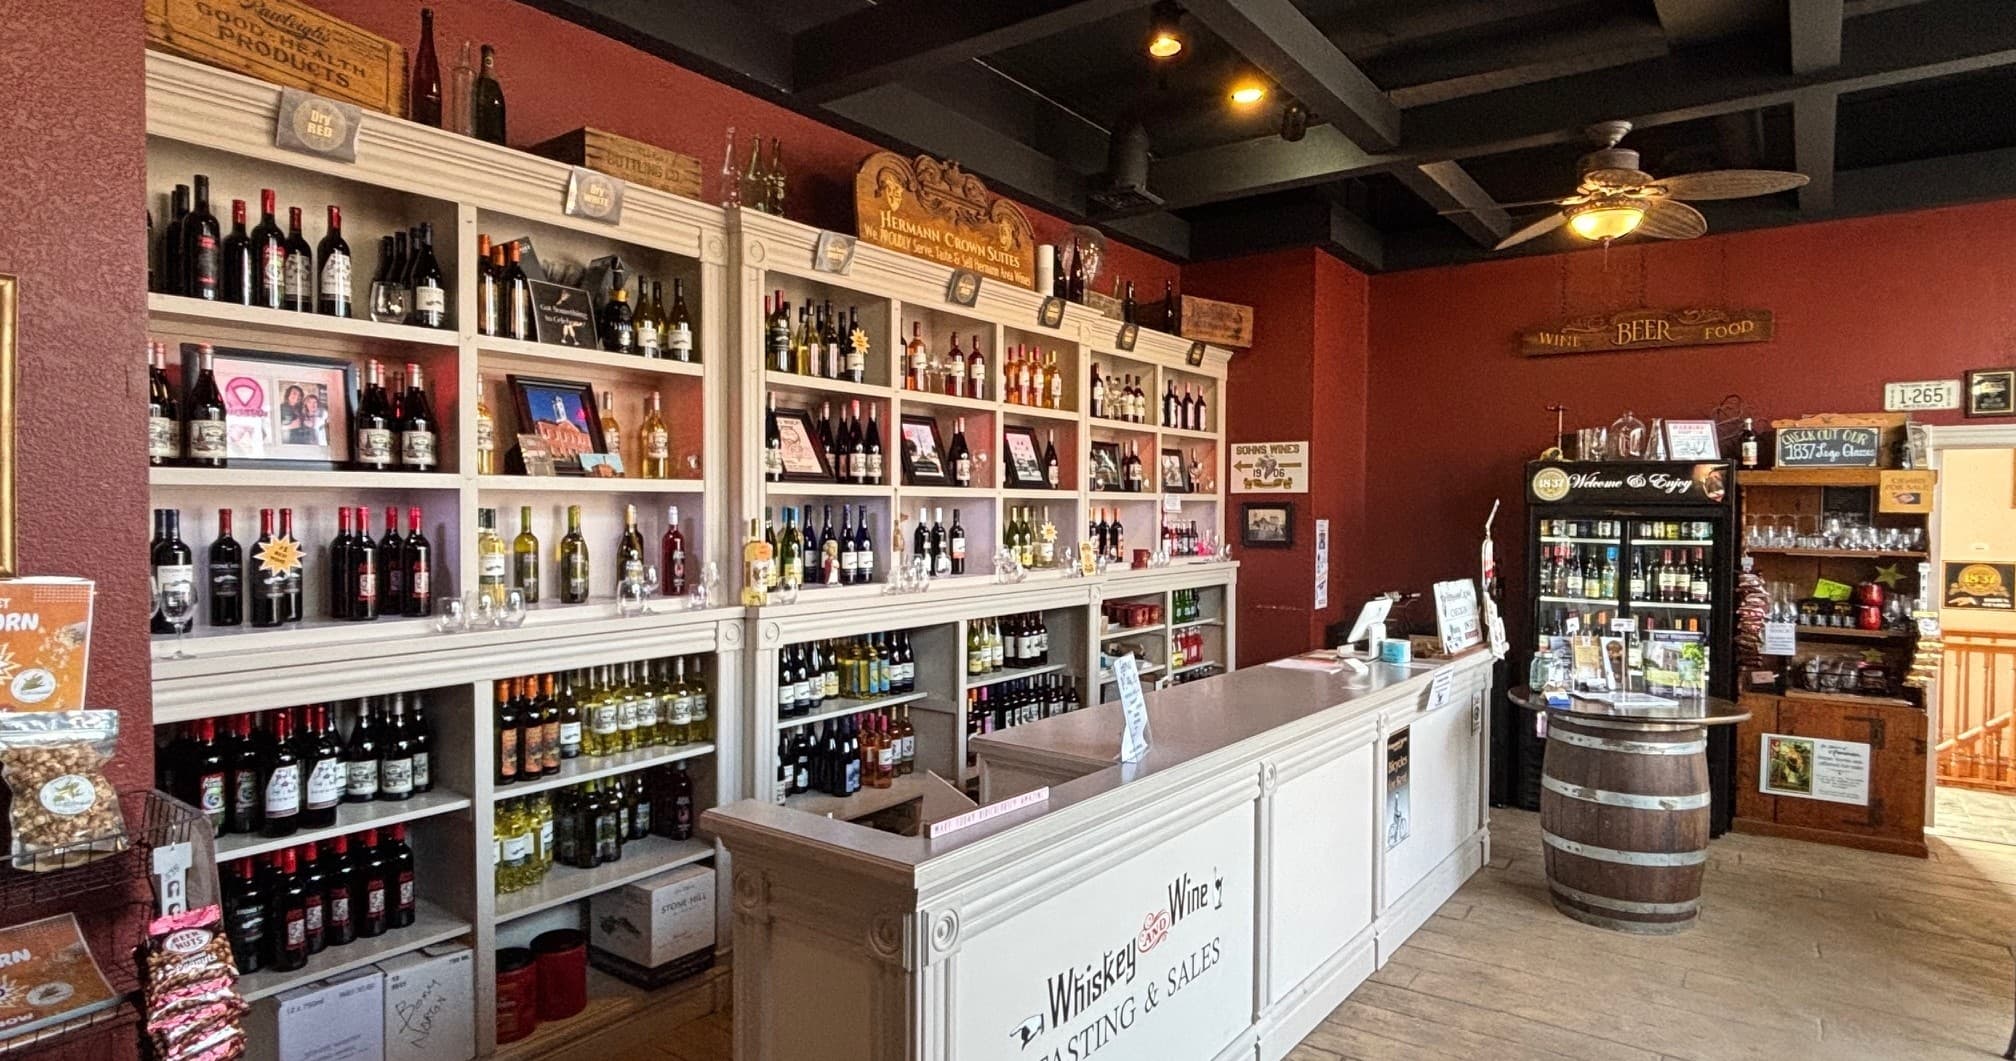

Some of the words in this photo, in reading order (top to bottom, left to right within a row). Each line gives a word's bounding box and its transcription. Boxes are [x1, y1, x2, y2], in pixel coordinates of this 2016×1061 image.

[217, 24, 351, 88] PRODUCTS
[310, 110, 331, 127] Dry
[306, 124, 333, 138] RED
[864, 222, 879, 240] We
[953, 251, 961, 265] &
[880, 210, 941, 242] HERMANN
[943, 232, 986, 256] CROWN
[986, 244, 1021, 269] SUITES
[1539, 331, 1582, 348] WINE
[1612, 319, 1674, 345] BEER
[1705, 320, 1755, 340] FOOD
[1781, 430, 1816, 446] CHECK
[1816, 429, 1839, 442] OUT
[1842, 430, 1869, 446] OUR
[1269, 444, 1300, 455] WINES
[1783, 443, 1816, 461] 1837
[1252, 469, 1262, 478] 19
[1273, 468, 1285, 478] 06
[1539, 478, 1565, 489] 1837
[1567, 471, 1623, 489] Welcome
[1626, 473, 1647, 488] &
[1648, 473, 1693, 494] Enjoy
[175, 935, 204, 950] NUTS
[1047, 938, 1137, 1029] Whiskey
[1141, 914, 1167, 949] AND
[1168, 872, 1208, 927] Wine
[1144, 981, 1160, 1014] &
[1166, 936, 1221, 998] SALES
